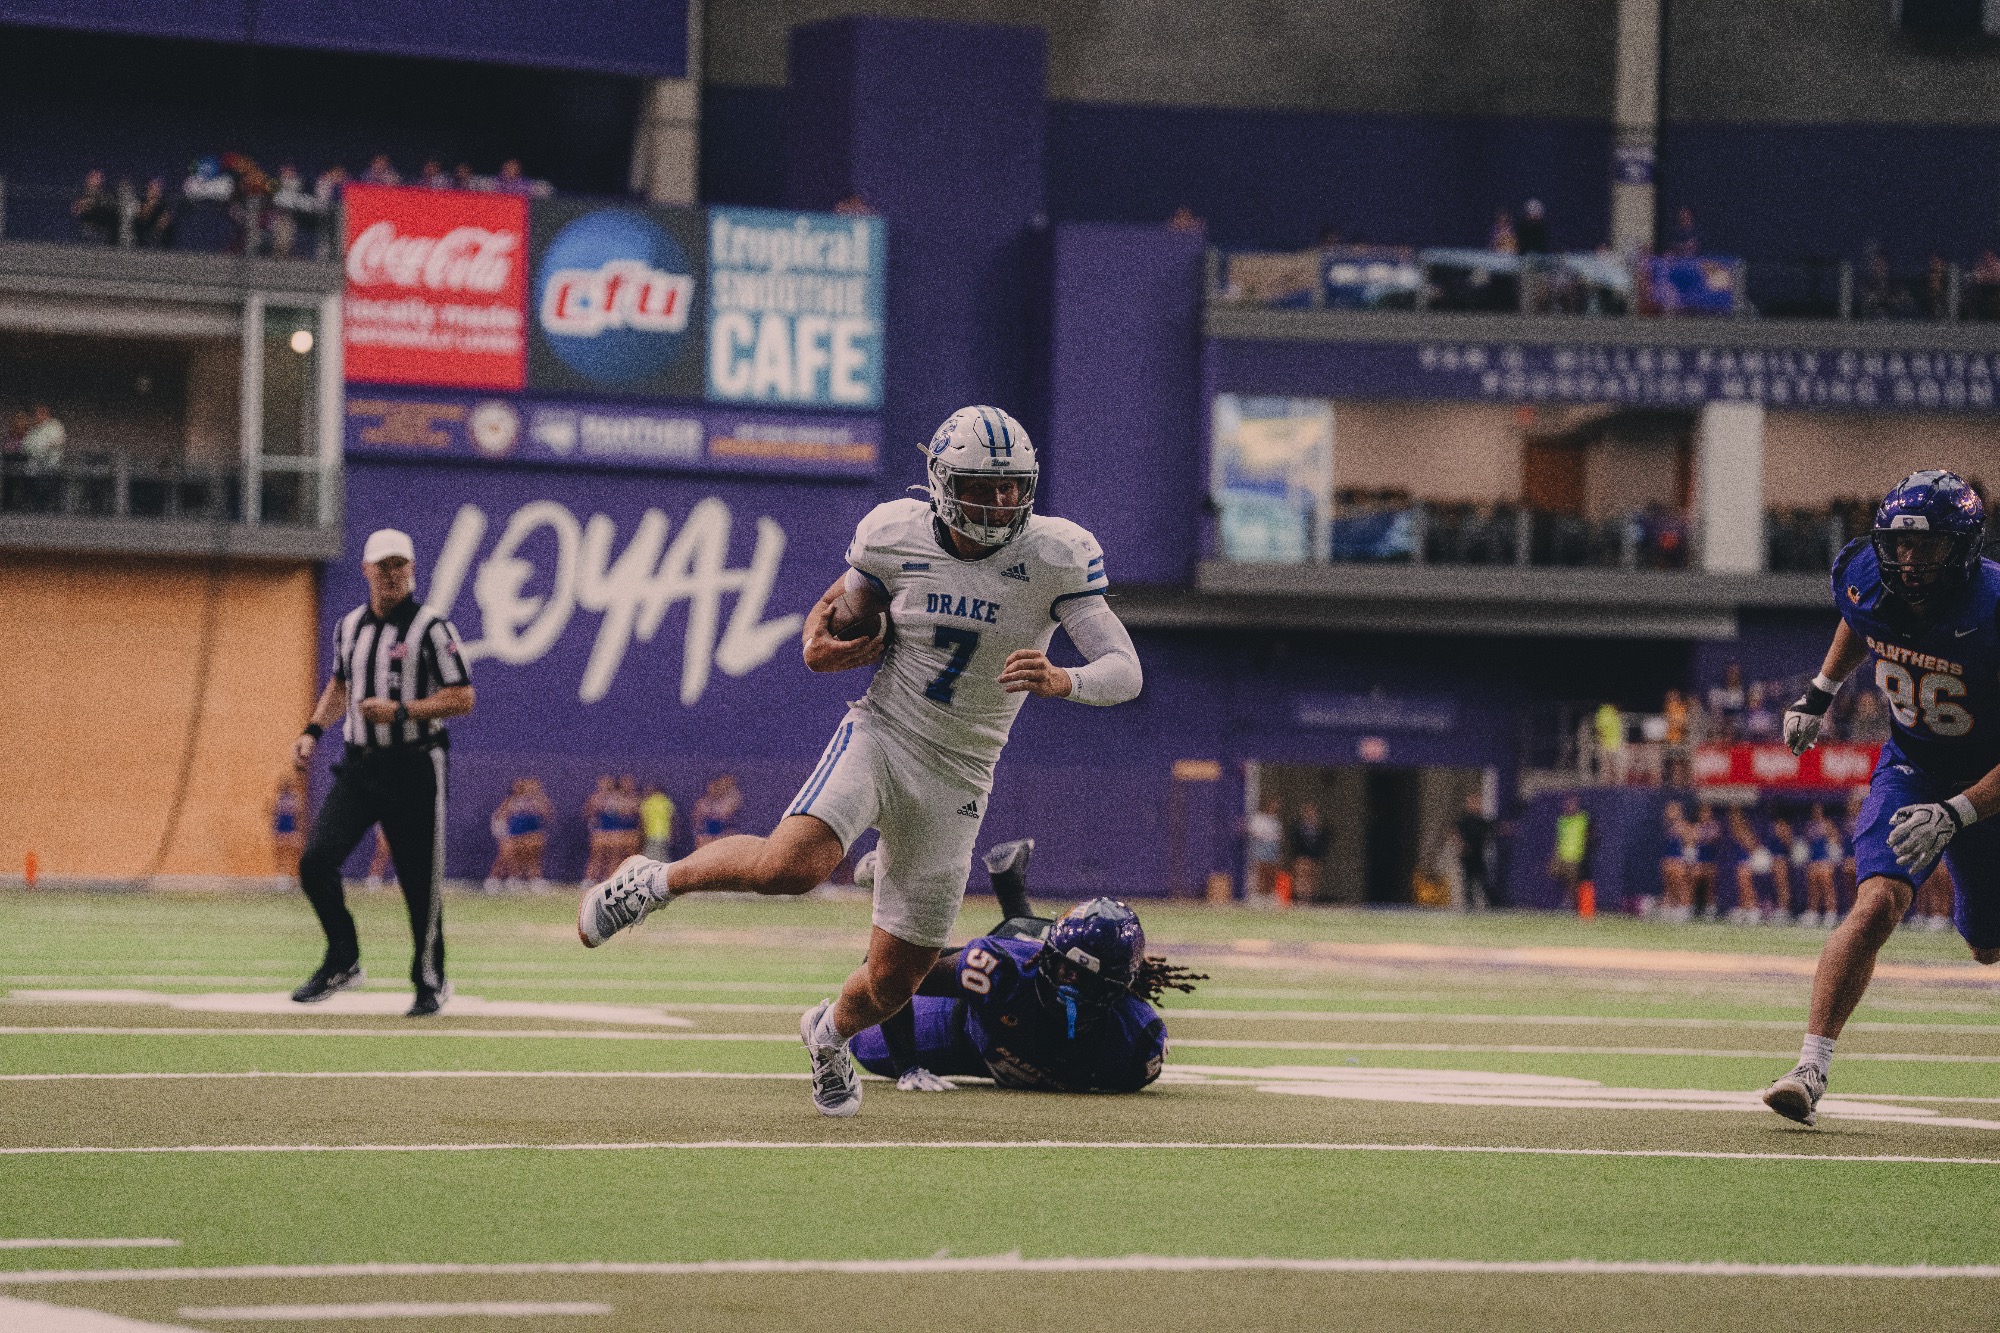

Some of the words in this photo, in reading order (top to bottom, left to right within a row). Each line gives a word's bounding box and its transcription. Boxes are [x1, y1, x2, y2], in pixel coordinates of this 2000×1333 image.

[714, 218, 868, 274] tropical
[711, 313, 873, 398] CAFE
[1836, 349, 2000, 379] CHARITA
[424, 497, 803, 706] LOYAL
[1001, 570, 1031, 582] adidas
[926, 593, 1000, 624] DRAKE
[925, 625, 981, 704] 7
[1866, 635, 1964, 676] PANTHERS
[1876, 659, 1974, 736] 96
[961, 948, 999, 995] 50
